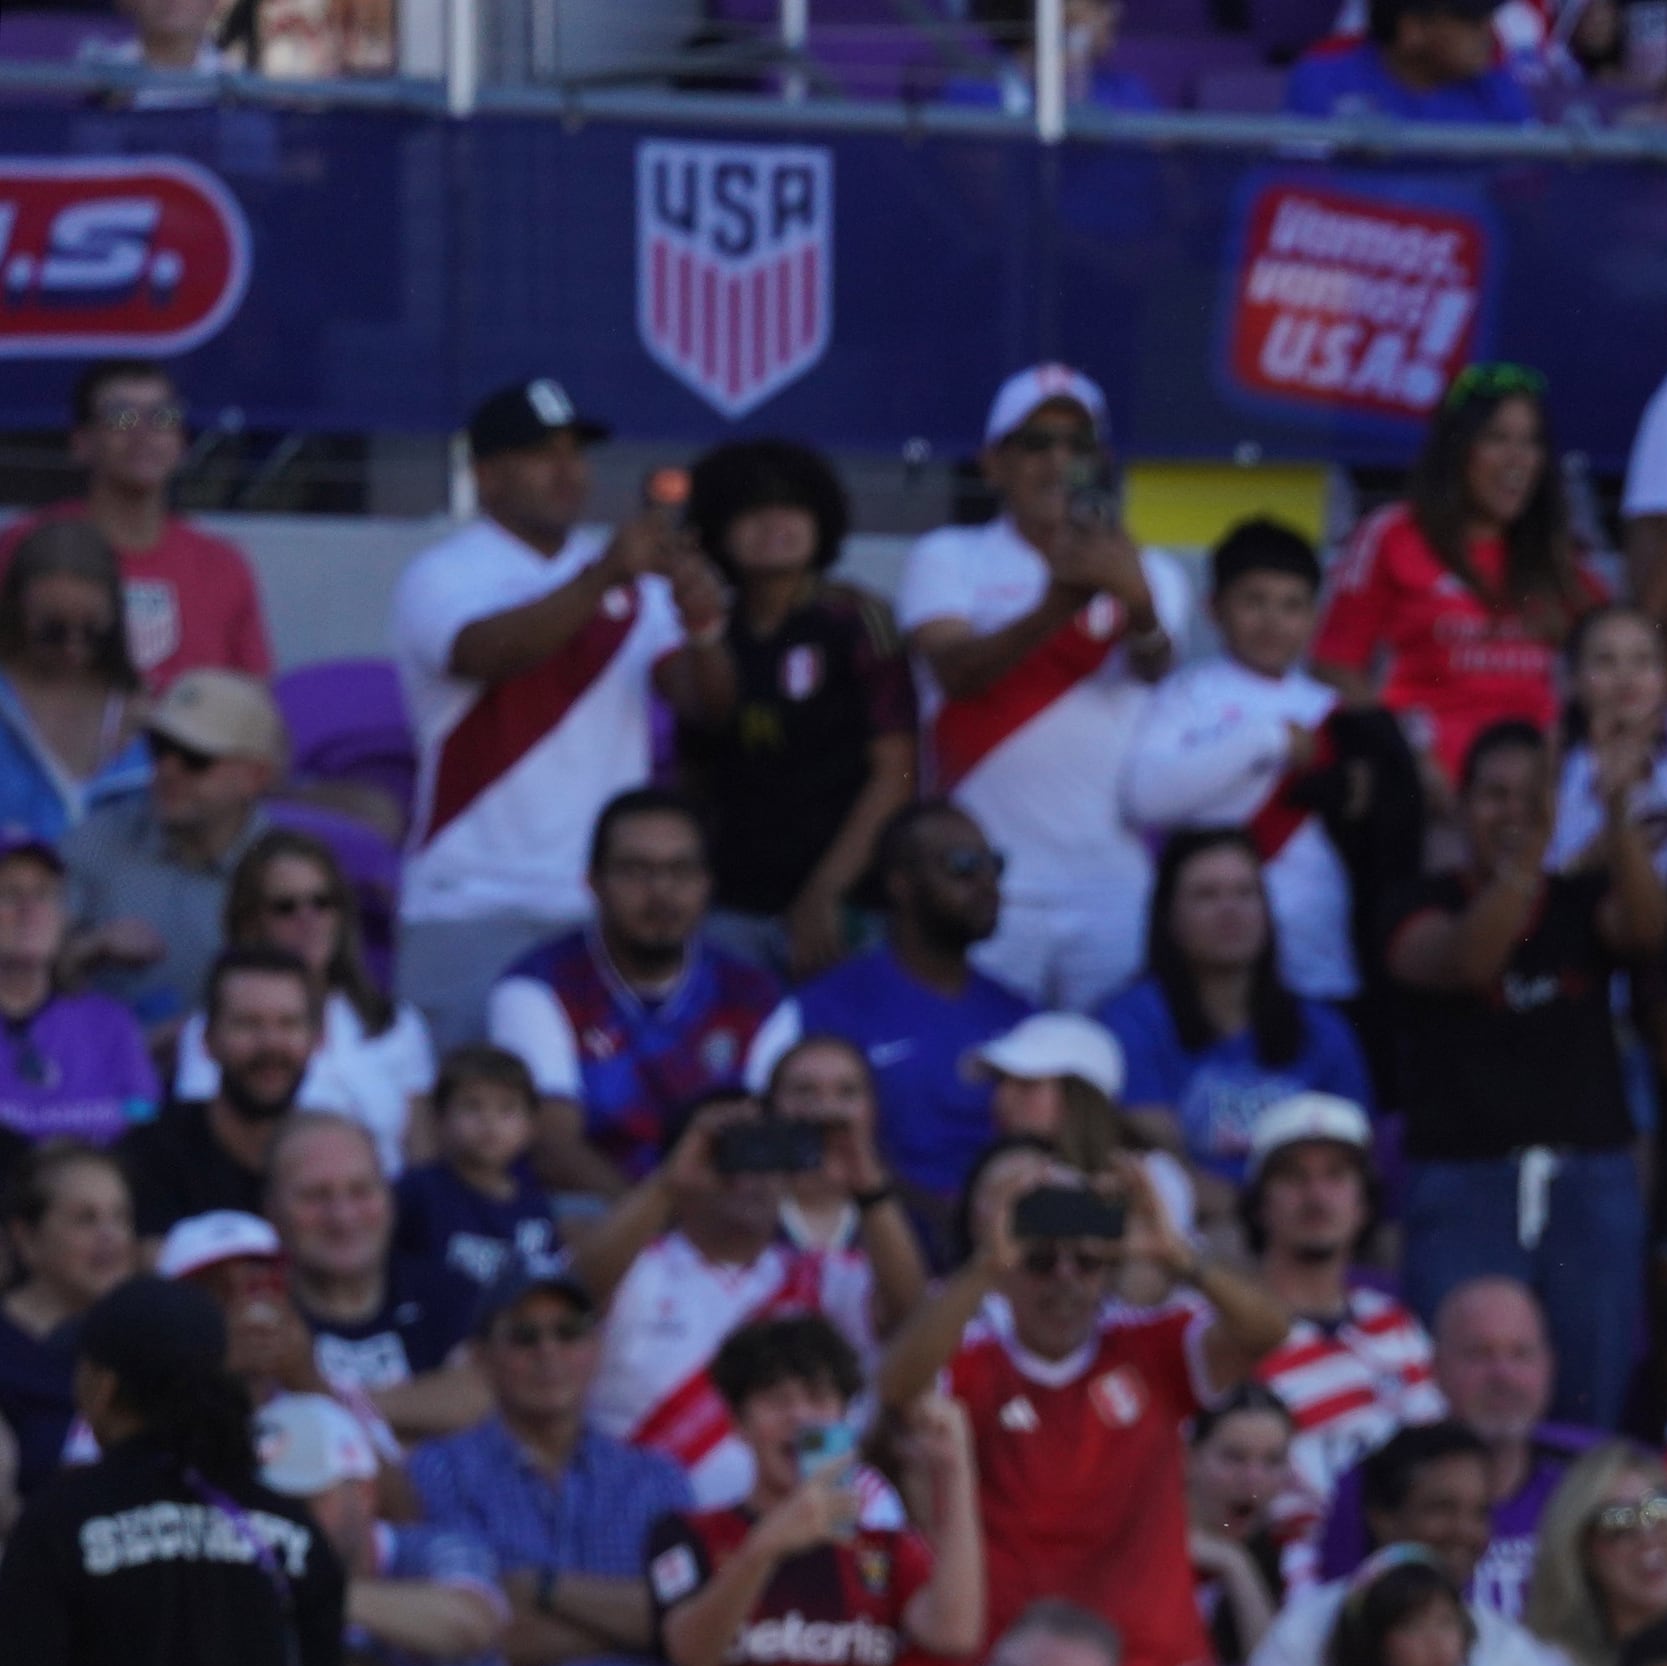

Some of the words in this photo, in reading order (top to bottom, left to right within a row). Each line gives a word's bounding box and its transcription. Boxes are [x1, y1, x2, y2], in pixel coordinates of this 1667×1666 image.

[0, 200, 183, 292] .S.
[656, 161, 815, 259] USA
[80, 1500, 312, 1577] SECURITY
